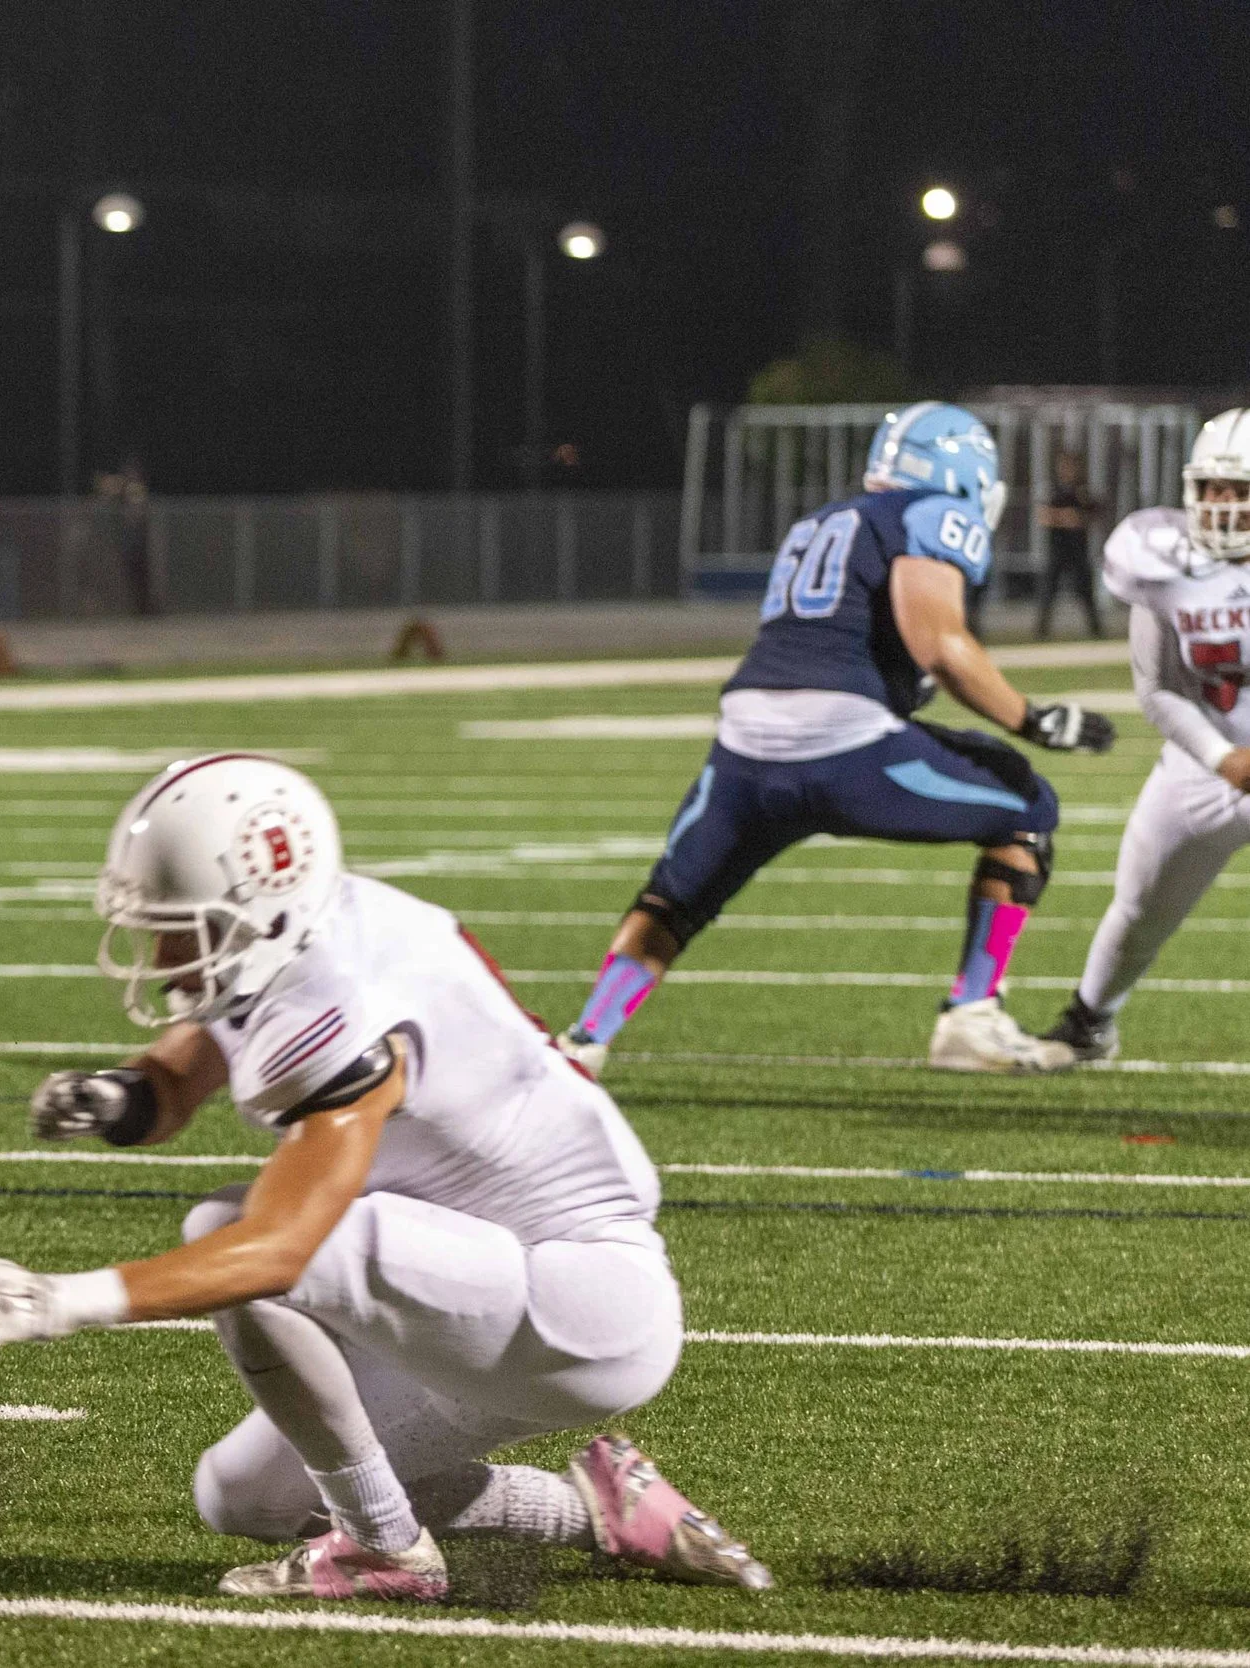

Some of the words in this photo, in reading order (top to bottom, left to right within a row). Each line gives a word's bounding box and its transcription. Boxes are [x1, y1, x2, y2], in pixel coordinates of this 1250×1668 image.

[939, 508, 989, 564] 60
[758, 508, 862, 624] 60
[1176, 606, 1250, 633] BECK
